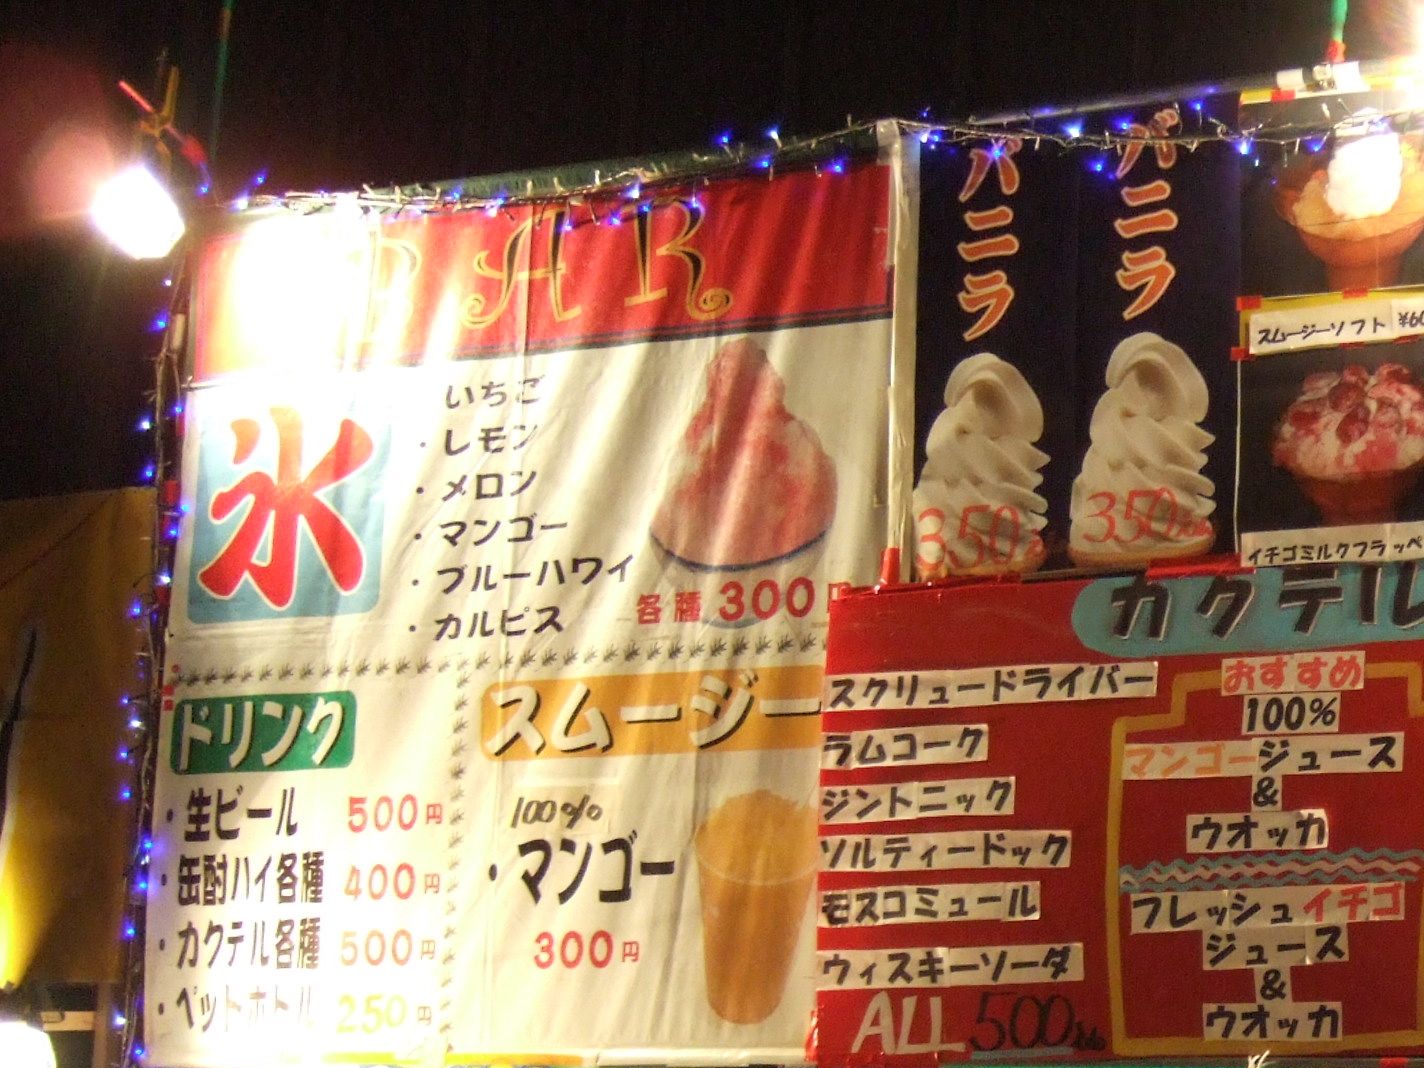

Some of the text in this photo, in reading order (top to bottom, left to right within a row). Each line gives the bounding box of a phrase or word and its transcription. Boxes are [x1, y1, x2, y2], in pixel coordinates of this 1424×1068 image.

[1114, 108, 1180, 321] バニラ
[958, 137, 1022, 341] バニラ
[1258, 316, 1385, 345] スムージーソフト
[446, 373, 545, 410] いちご
[443, 421, 539, 457] レモン
[440, 471, 539, 501] メロン
[198, 406, 374, 609] 氷
[438, 514, 569, 548] マンゴー
[1248, 535, 1424, 566] イチゴミルクフラッペ
[435, 552, 636, 588] ブルーハワイ
[433, 608, 564, 644] カルピス
[828, 665, 1154, 711] スクリュードライバー
[1225, 655, 1364, 694] おすすめ
[486, 669, 822, 757] スムージー
[1246, 697, 1337, 732] 100%
[175, 693, 342, 774] ドリンク
[822, 726, 984, 768] ラムコーク
[820, 779, 1013, 821] ジントニック
[1253, 777, 1280, 807] &
[183, 785, 300, 844] 生ビール
[509, 794, 604, 830] 100%
[1190, 811, 1328, 849] ウオッカ
[515, 829, 677, 906] マンゴー
[820, 831, 1069, 870] ソルティードック
[821, 884, 1038, 925] モスコミュール
[176, 916, 321, 970] カクテル各種
[1206, 926, 1346, 965] ジュース
[822, 946, 1071, 986] ウィスキーソーダ
[1259, 968, 1288, 1000] &
[851, 990, 967, 1055] ALL
[1205, 1003, 1341, 1041] ウオッカ
